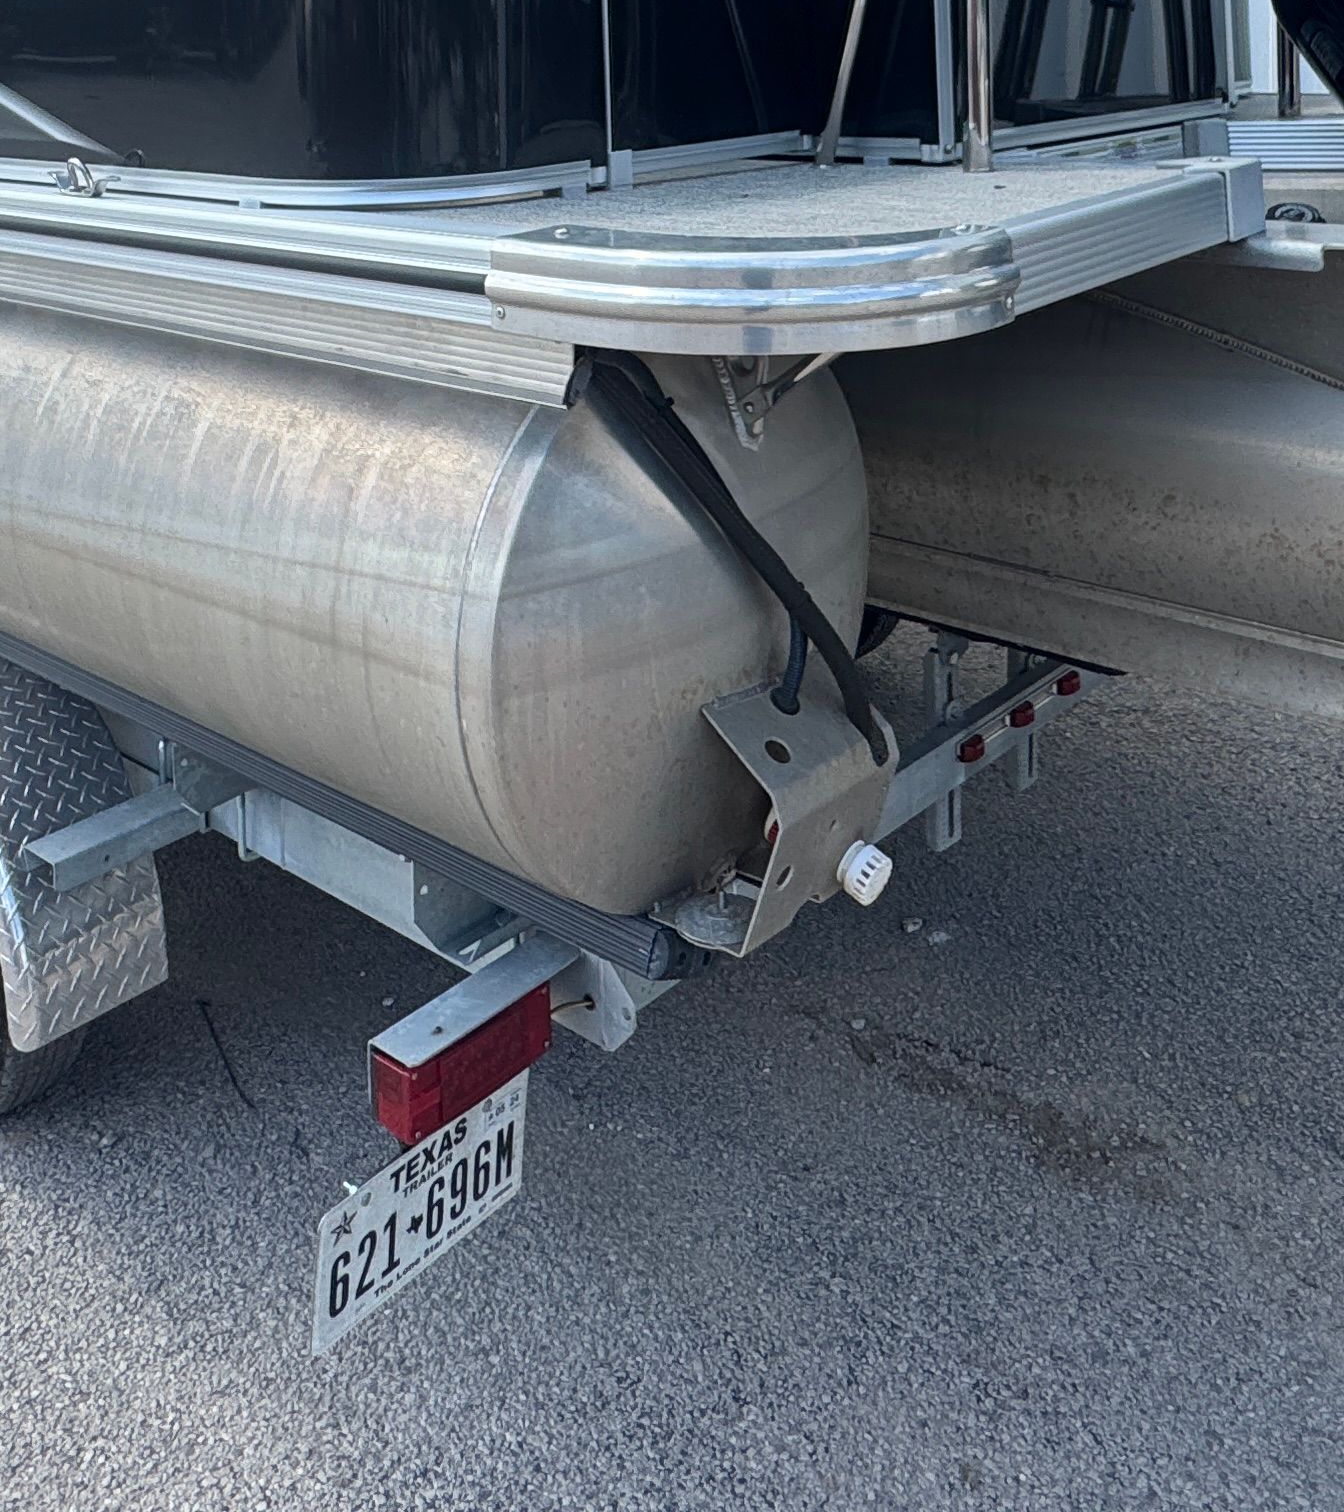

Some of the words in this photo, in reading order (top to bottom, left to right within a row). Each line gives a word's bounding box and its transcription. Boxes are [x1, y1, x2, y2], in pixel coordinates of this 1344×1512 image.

[389, 1117, 468, 1193] TEXAS
[402, 1152, 454, 1198] TRAILER
[329, 1210, 401, 1319] 621
[425, 1119, 515, 1240] 696M
[374, 1279, 394, 1298] The
[396, 1256, 422, 1280] Lone
[423, 1238, 444, 1259] Star
[446, 1215, 473, 1240] State
